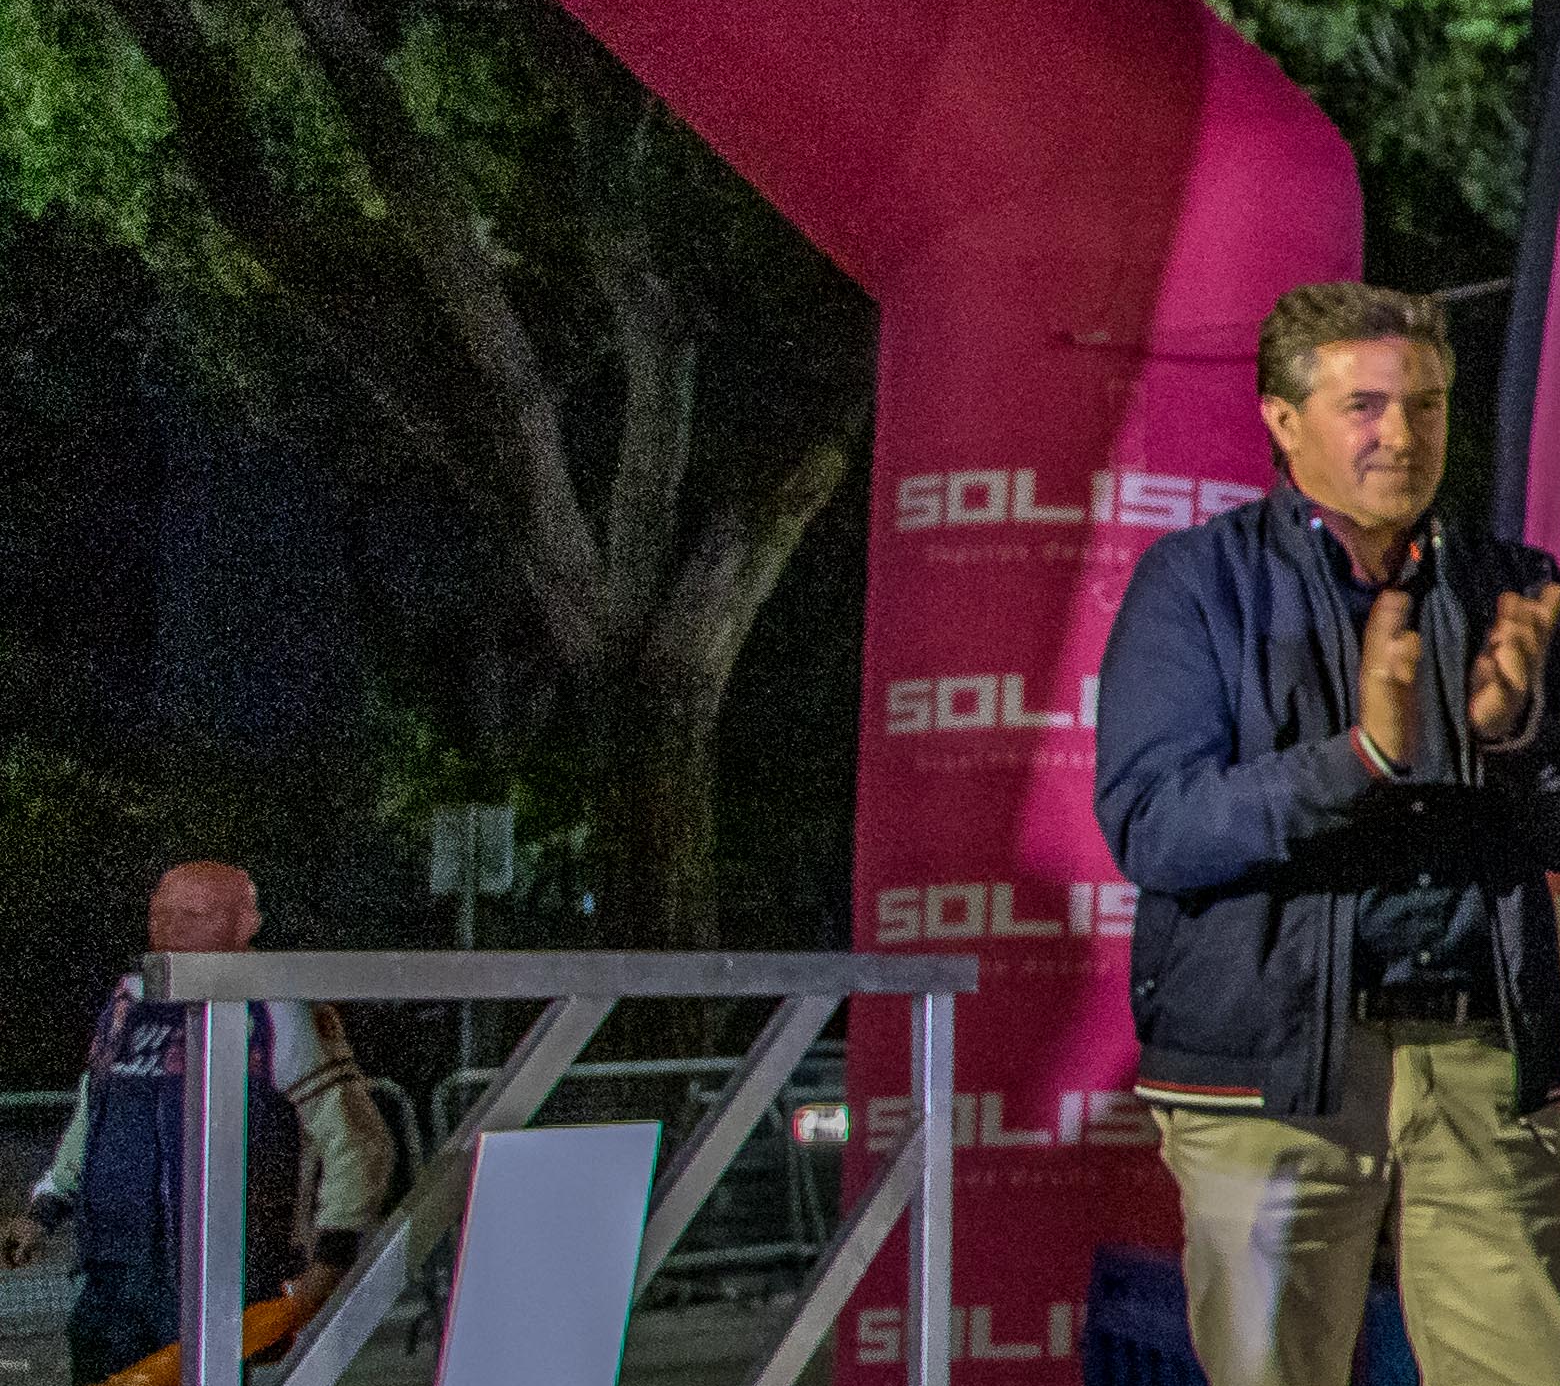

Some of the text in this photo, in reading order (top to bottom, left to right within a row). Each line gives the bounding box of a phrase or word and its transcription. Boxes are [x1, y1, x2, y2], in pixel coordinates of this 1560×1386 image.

[897, 468, 1264, 531] SOLISS
[886, 674, 1098, 736] SOLI
[876, 881, 1141, 944] SOLIS
[866, 1091, 1161, 1151] SLIS
[857, 1300, 1086, 1364] SLI
